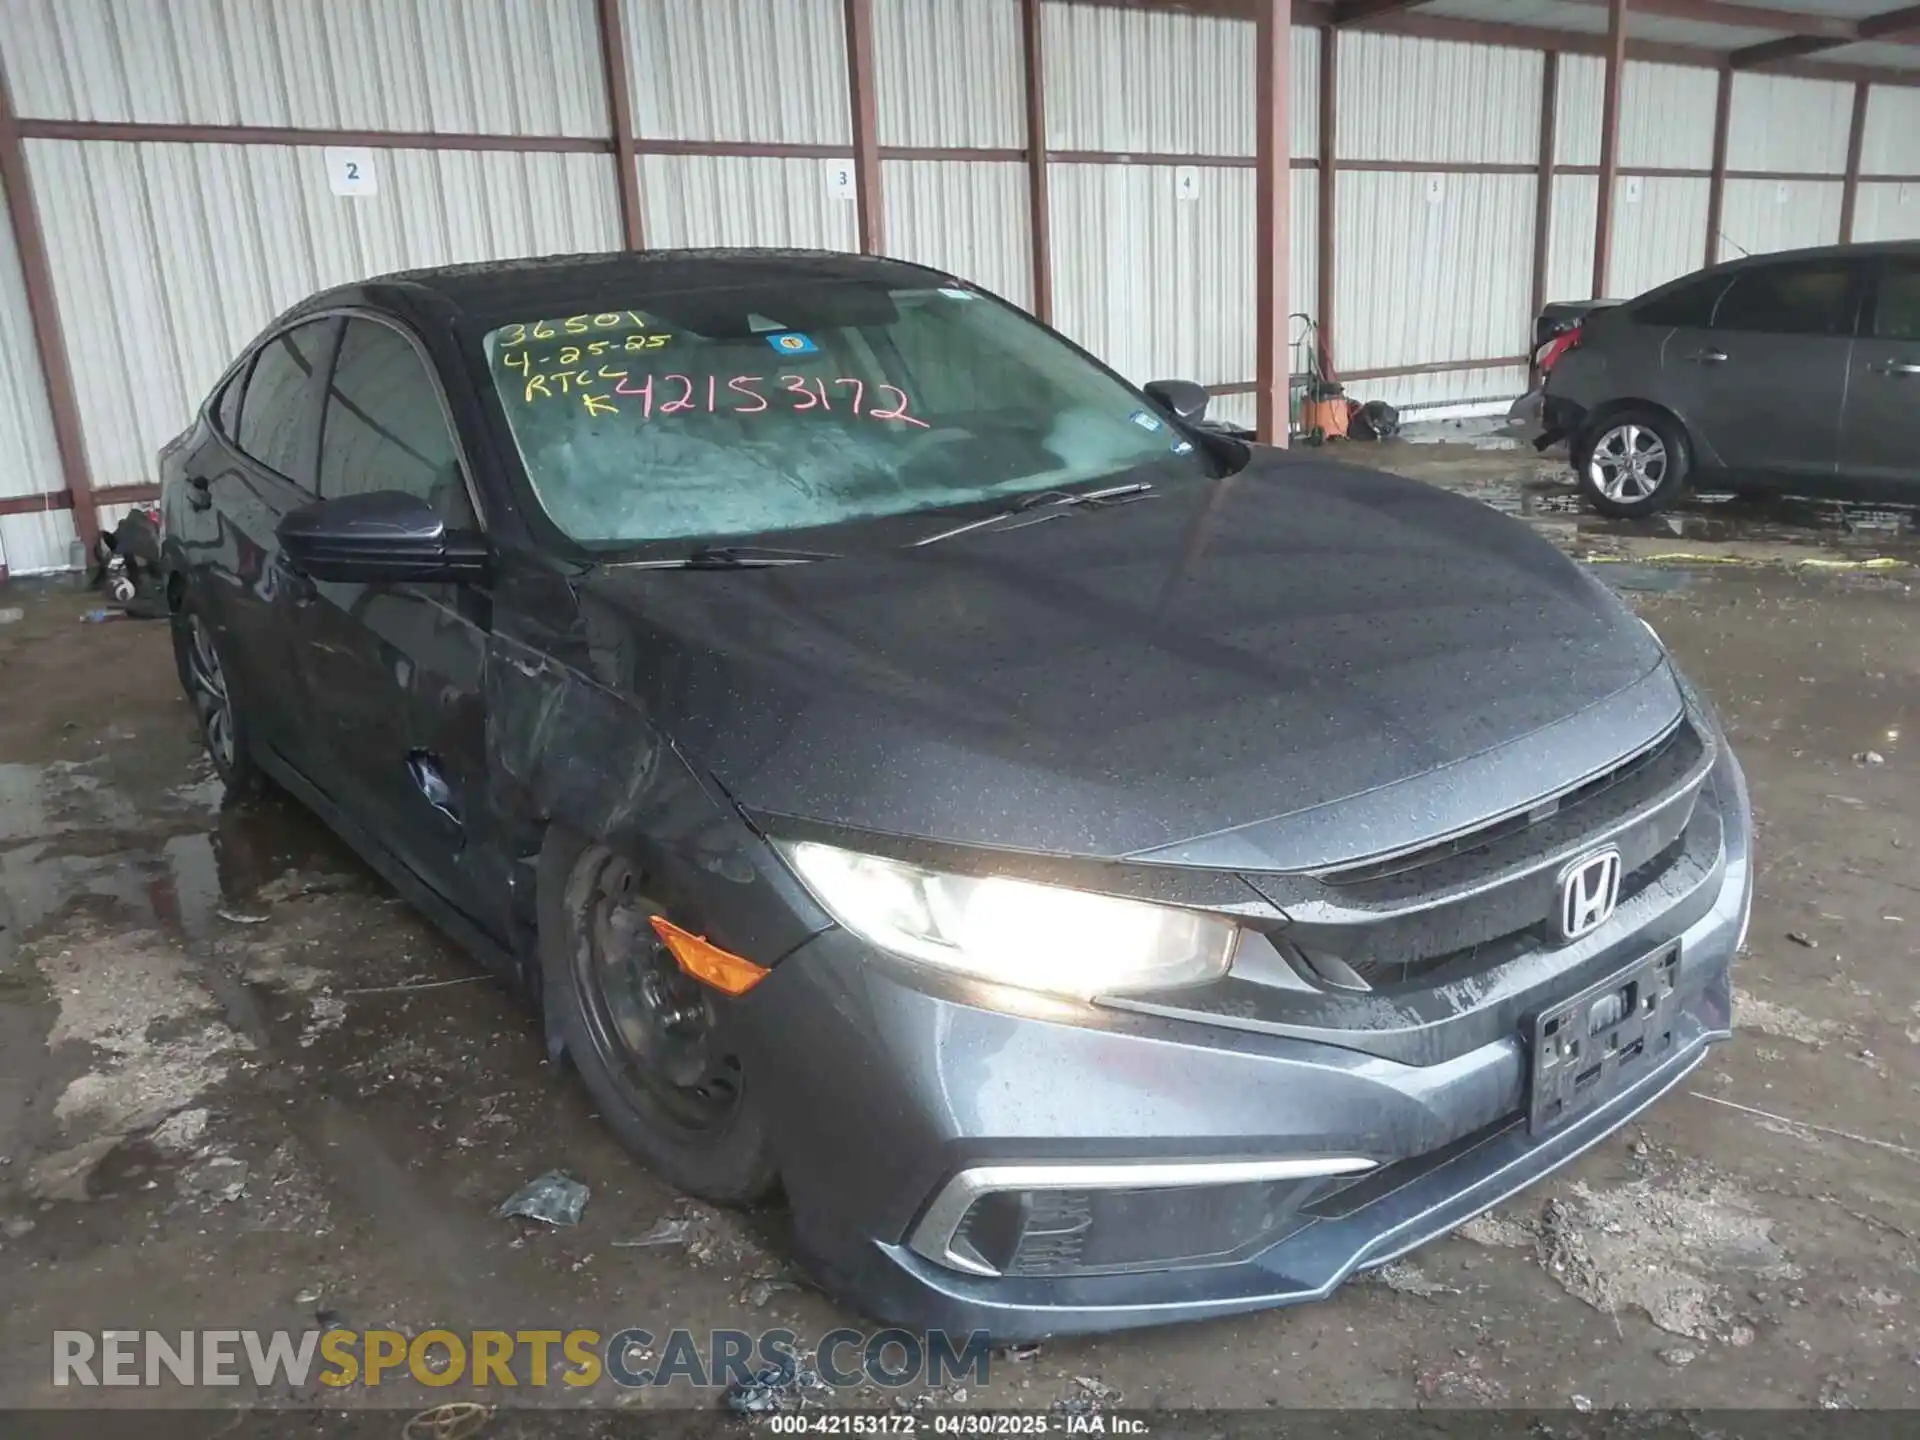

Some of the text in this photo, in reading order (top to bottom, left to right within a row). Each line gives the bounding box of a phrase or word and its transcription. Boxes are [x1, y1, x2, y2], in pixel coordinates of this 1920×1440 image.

[346, 162, 360, 180] 2
[839, 171, 848, 186] 3
[1183, 175, 1191, 189] 4
[500, 310, 645, 347] 36501
[504, 334, 672, 376] 4-25-25
[583, 393, 620, 417] K
[615, 374, 930, 428] 42153172
